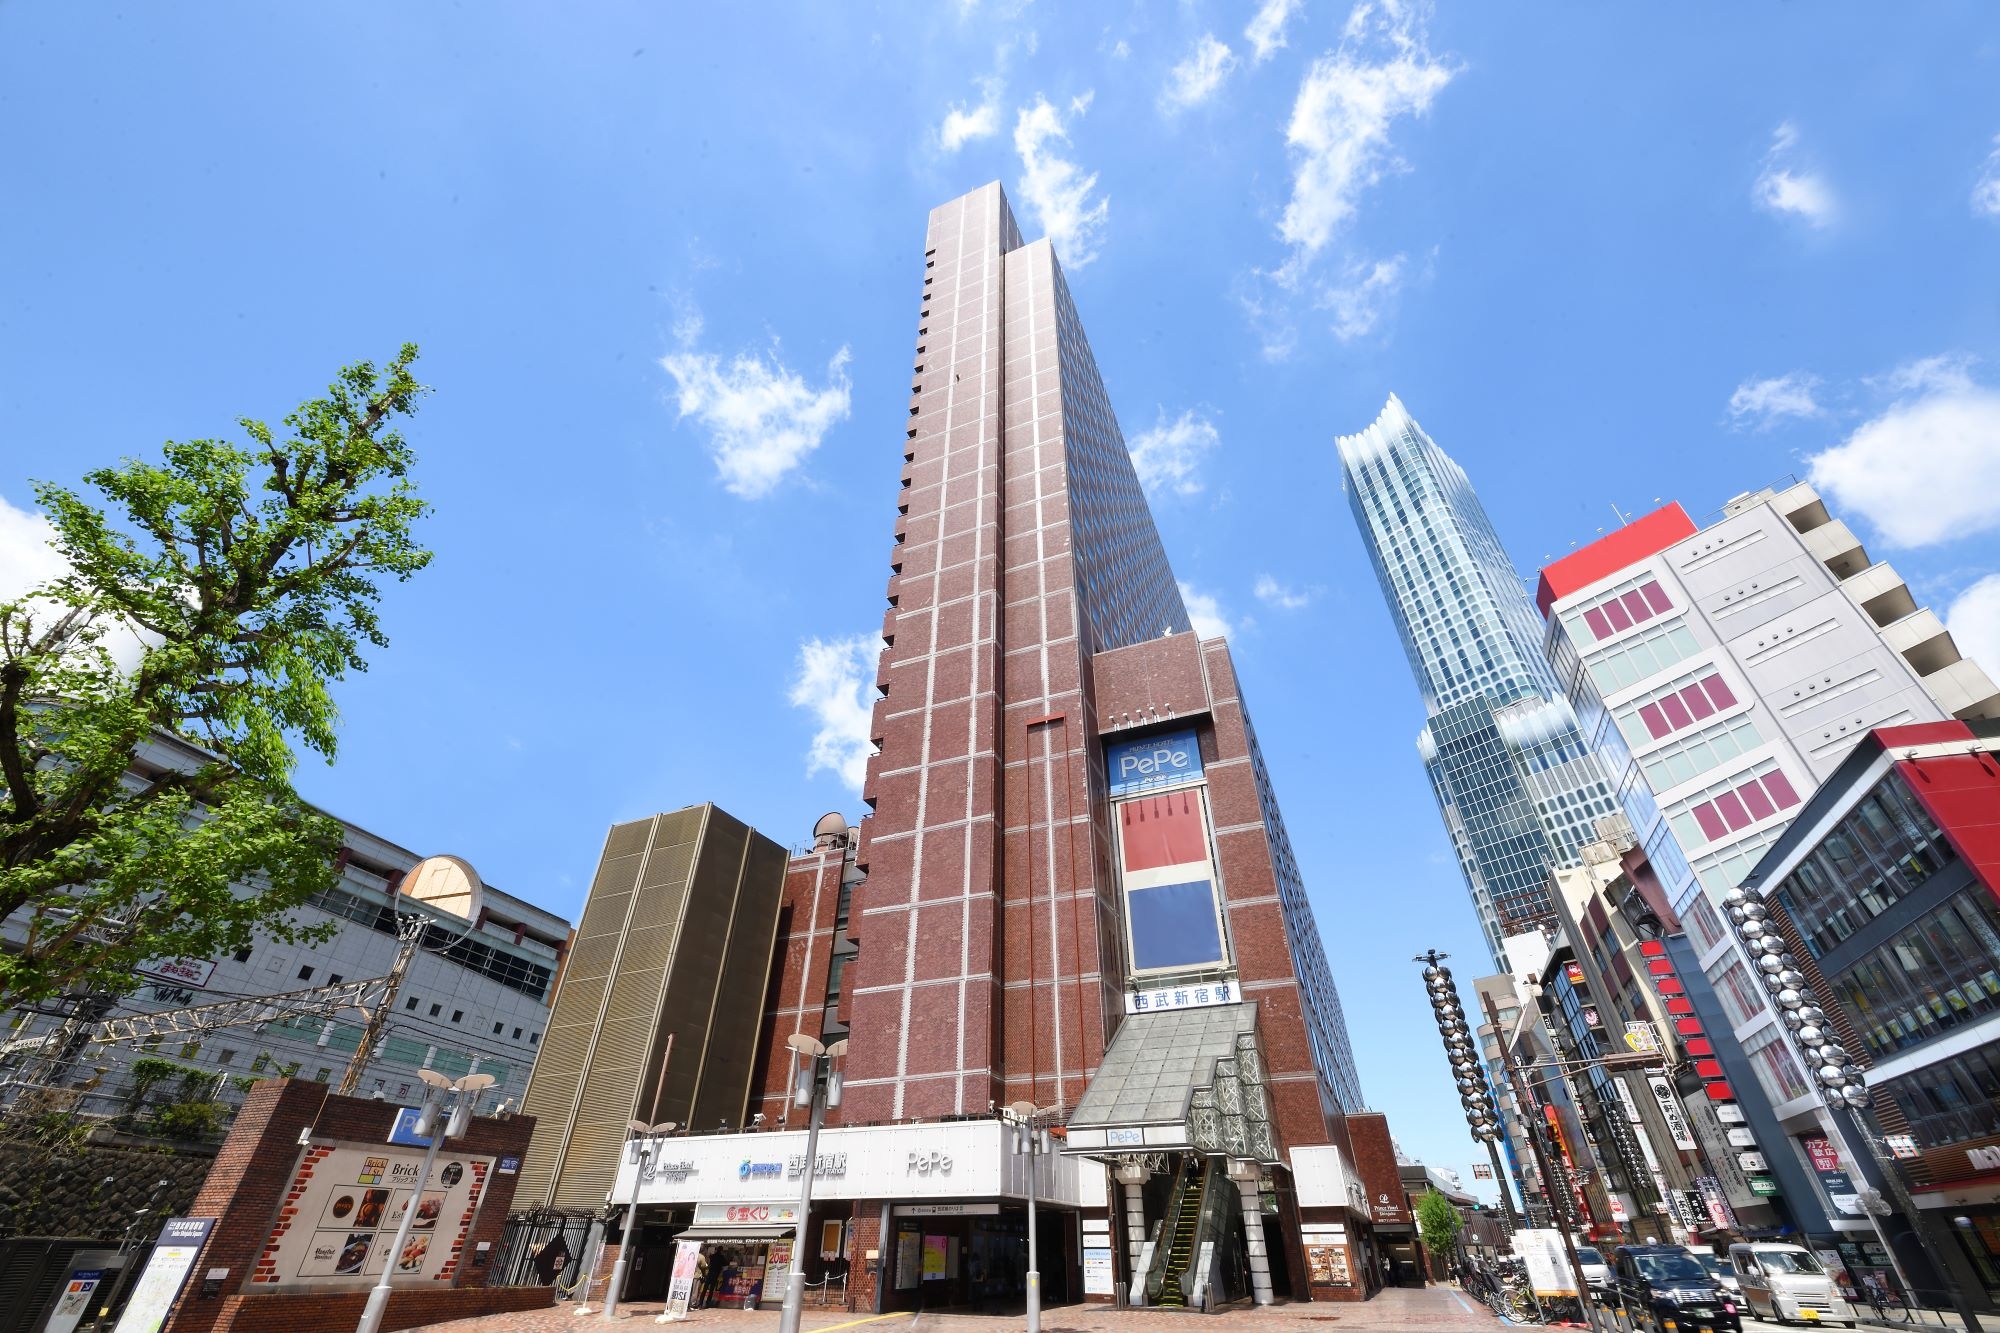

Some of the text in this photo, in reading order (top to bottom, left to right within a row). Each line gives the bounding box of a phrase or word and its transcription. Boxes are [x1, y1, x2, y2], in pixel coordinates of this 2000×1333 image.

[1120, 749, 1188, 778] PePe
[1134, 985, 1231, 1010] 西武新宿駅
[1110, 1130, 1140, 1144] PePe
[392, 1163, 420, 1177] Brick
[906, 1150, 953, 1171] PePe
